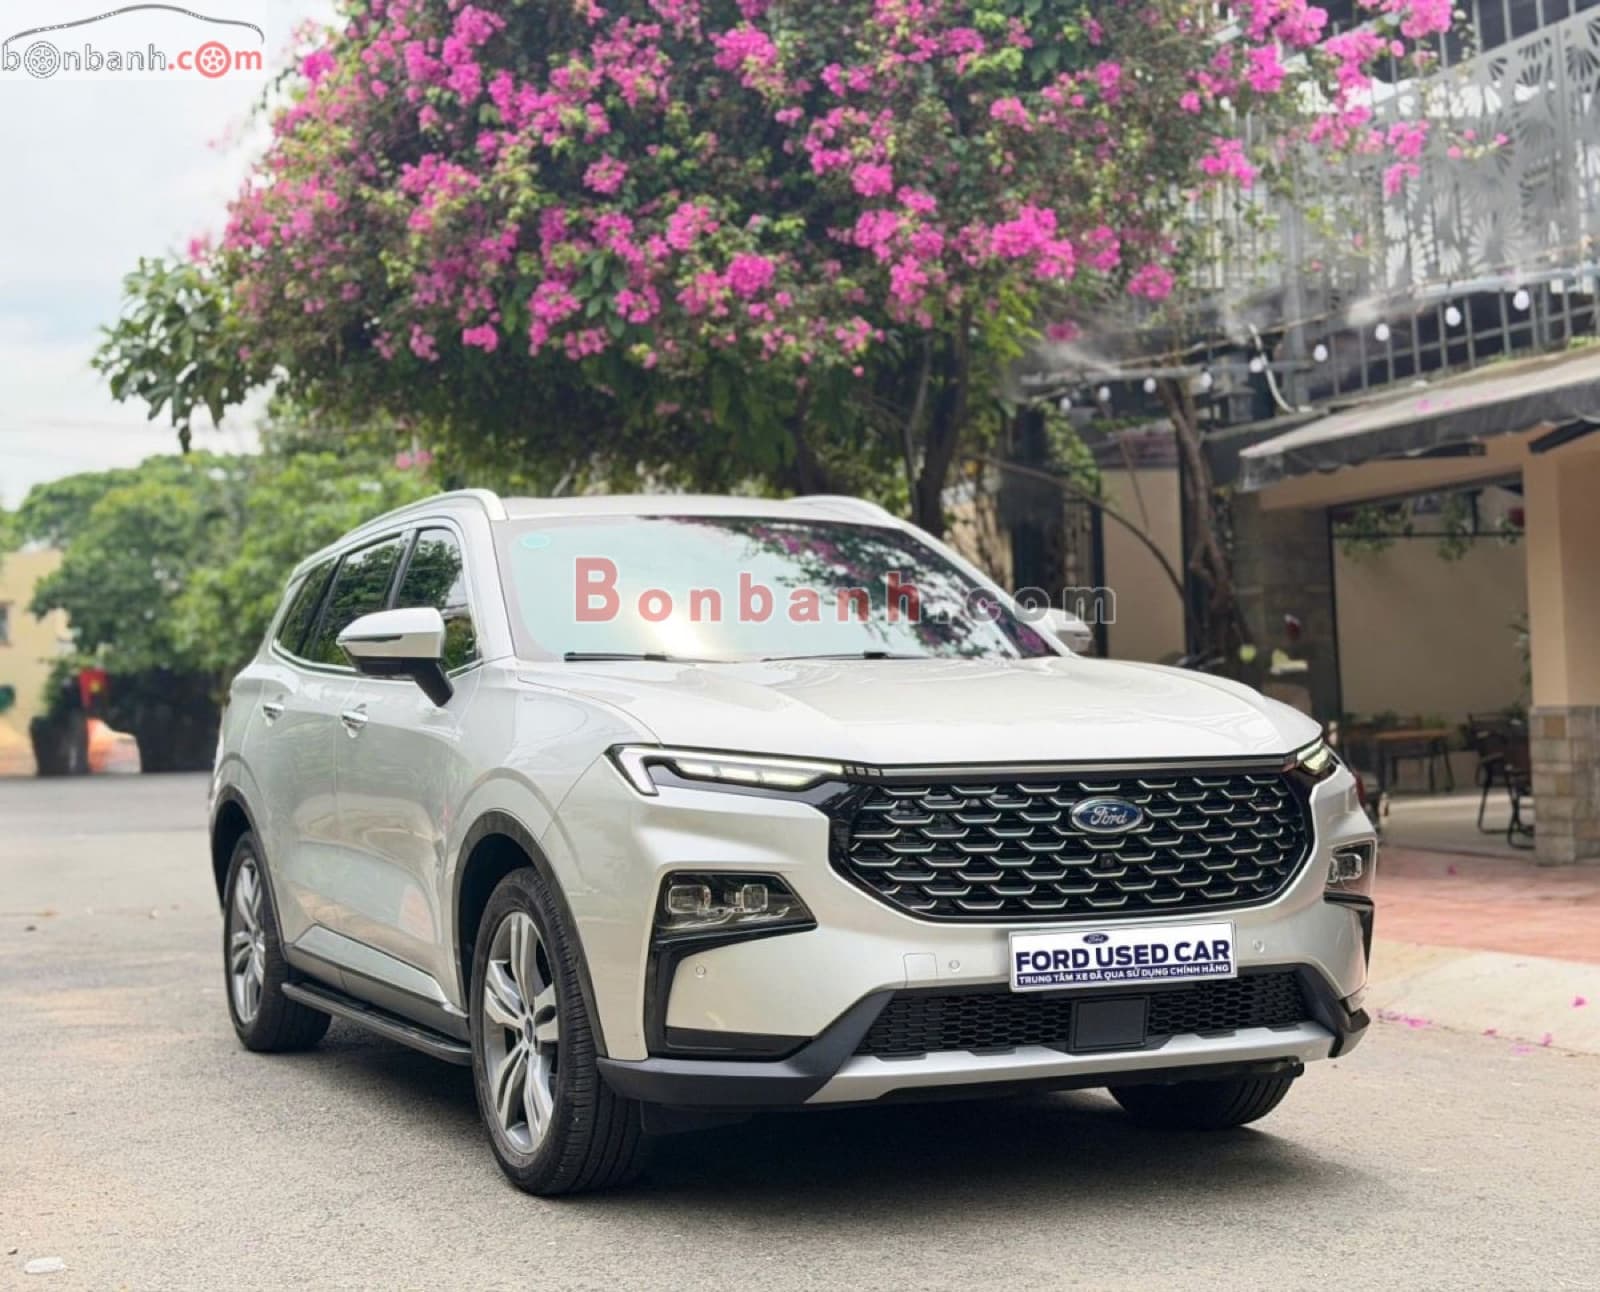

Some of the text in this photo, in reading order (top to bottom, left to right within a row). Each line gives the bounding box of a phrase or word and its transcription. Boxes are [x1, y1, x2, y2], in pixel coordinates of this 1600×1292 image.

[1089, 806, 1129, 825] Ford
[1016, 940, 1230, 972] FORD USED CAR
[1019, 974, 1052, 985] TRUNG
[1054, 971, 1074, 982] TÂM
[1075, 971, 1089, 981] XE
[1103, 969, 1125, 981] QUA
[1141, 967, 1169, 979] DỤNG
[1170, 964, 1201, 976] CHÍNH
